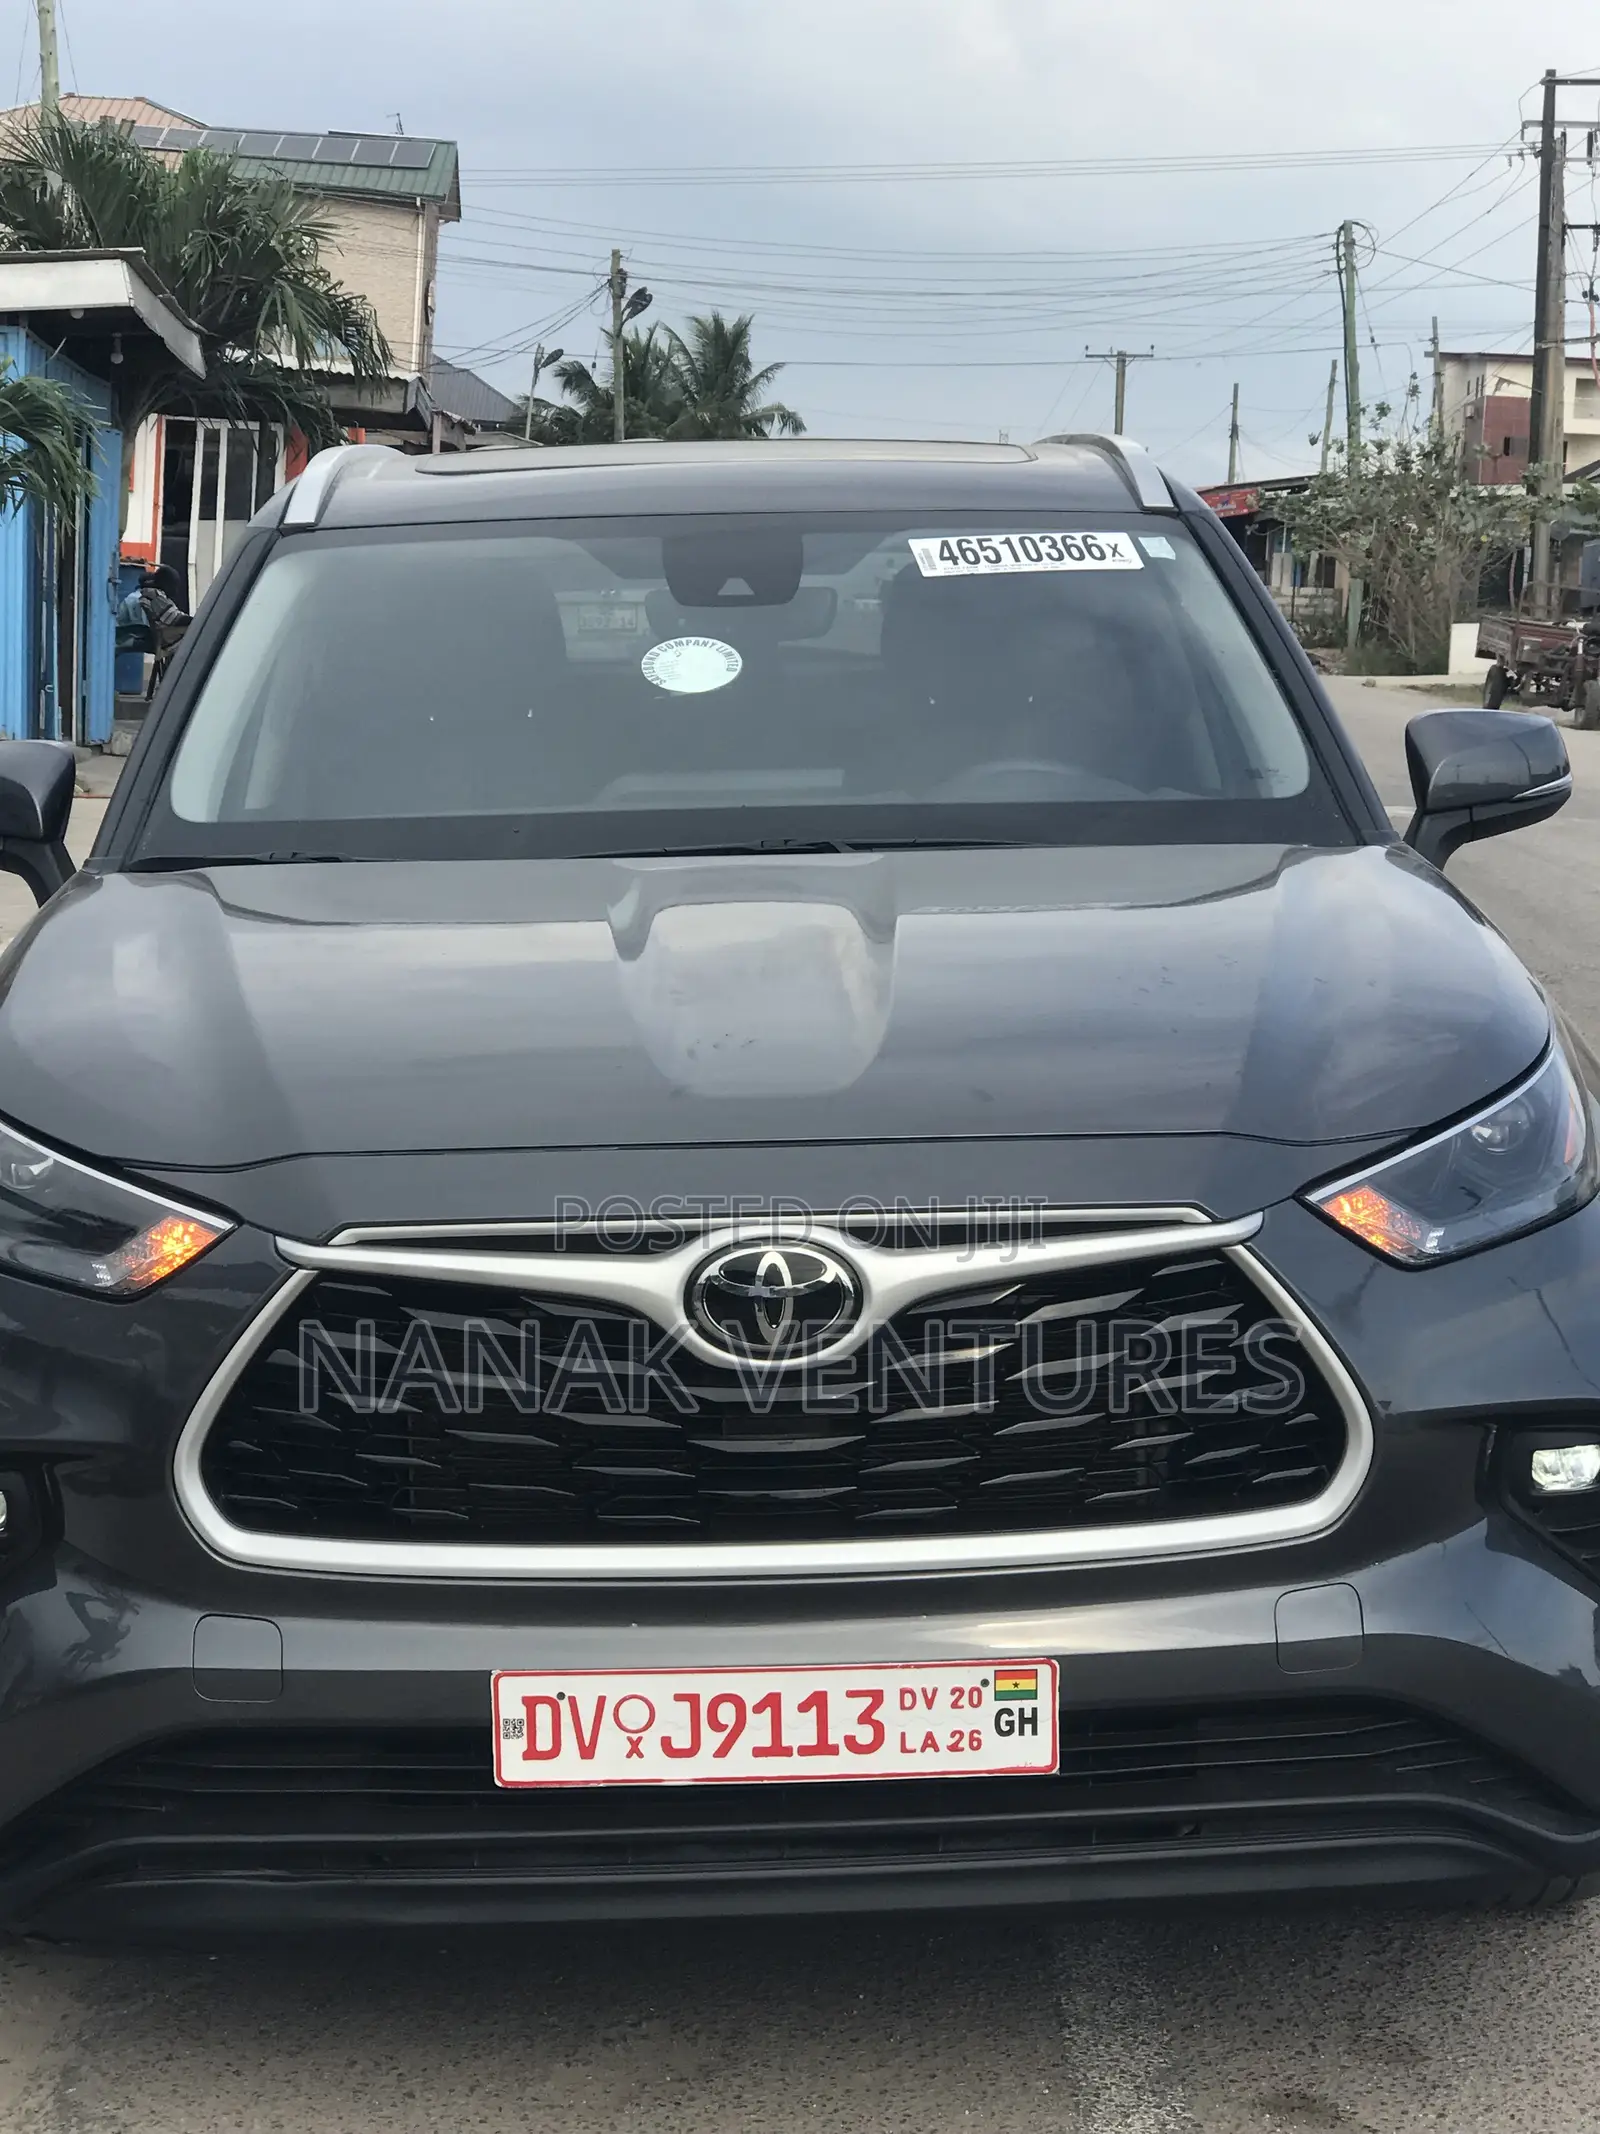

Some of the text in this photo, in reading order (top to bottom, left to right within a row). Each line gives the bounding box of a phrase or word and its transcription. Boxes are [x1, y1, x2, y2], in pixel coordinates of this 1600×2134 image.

[938, 534, 1107, 566] 46510366
[657, 639, 718, 653] COMPANY
[715, 645, 739, 673] LIMITED
[899, 1686, 983, 1711] DV 20
[660, 1689, 886, 1758] J9113
[994, 1707, 1038, 1737] GH
[900, 1729, 982, 1753] LA 26
